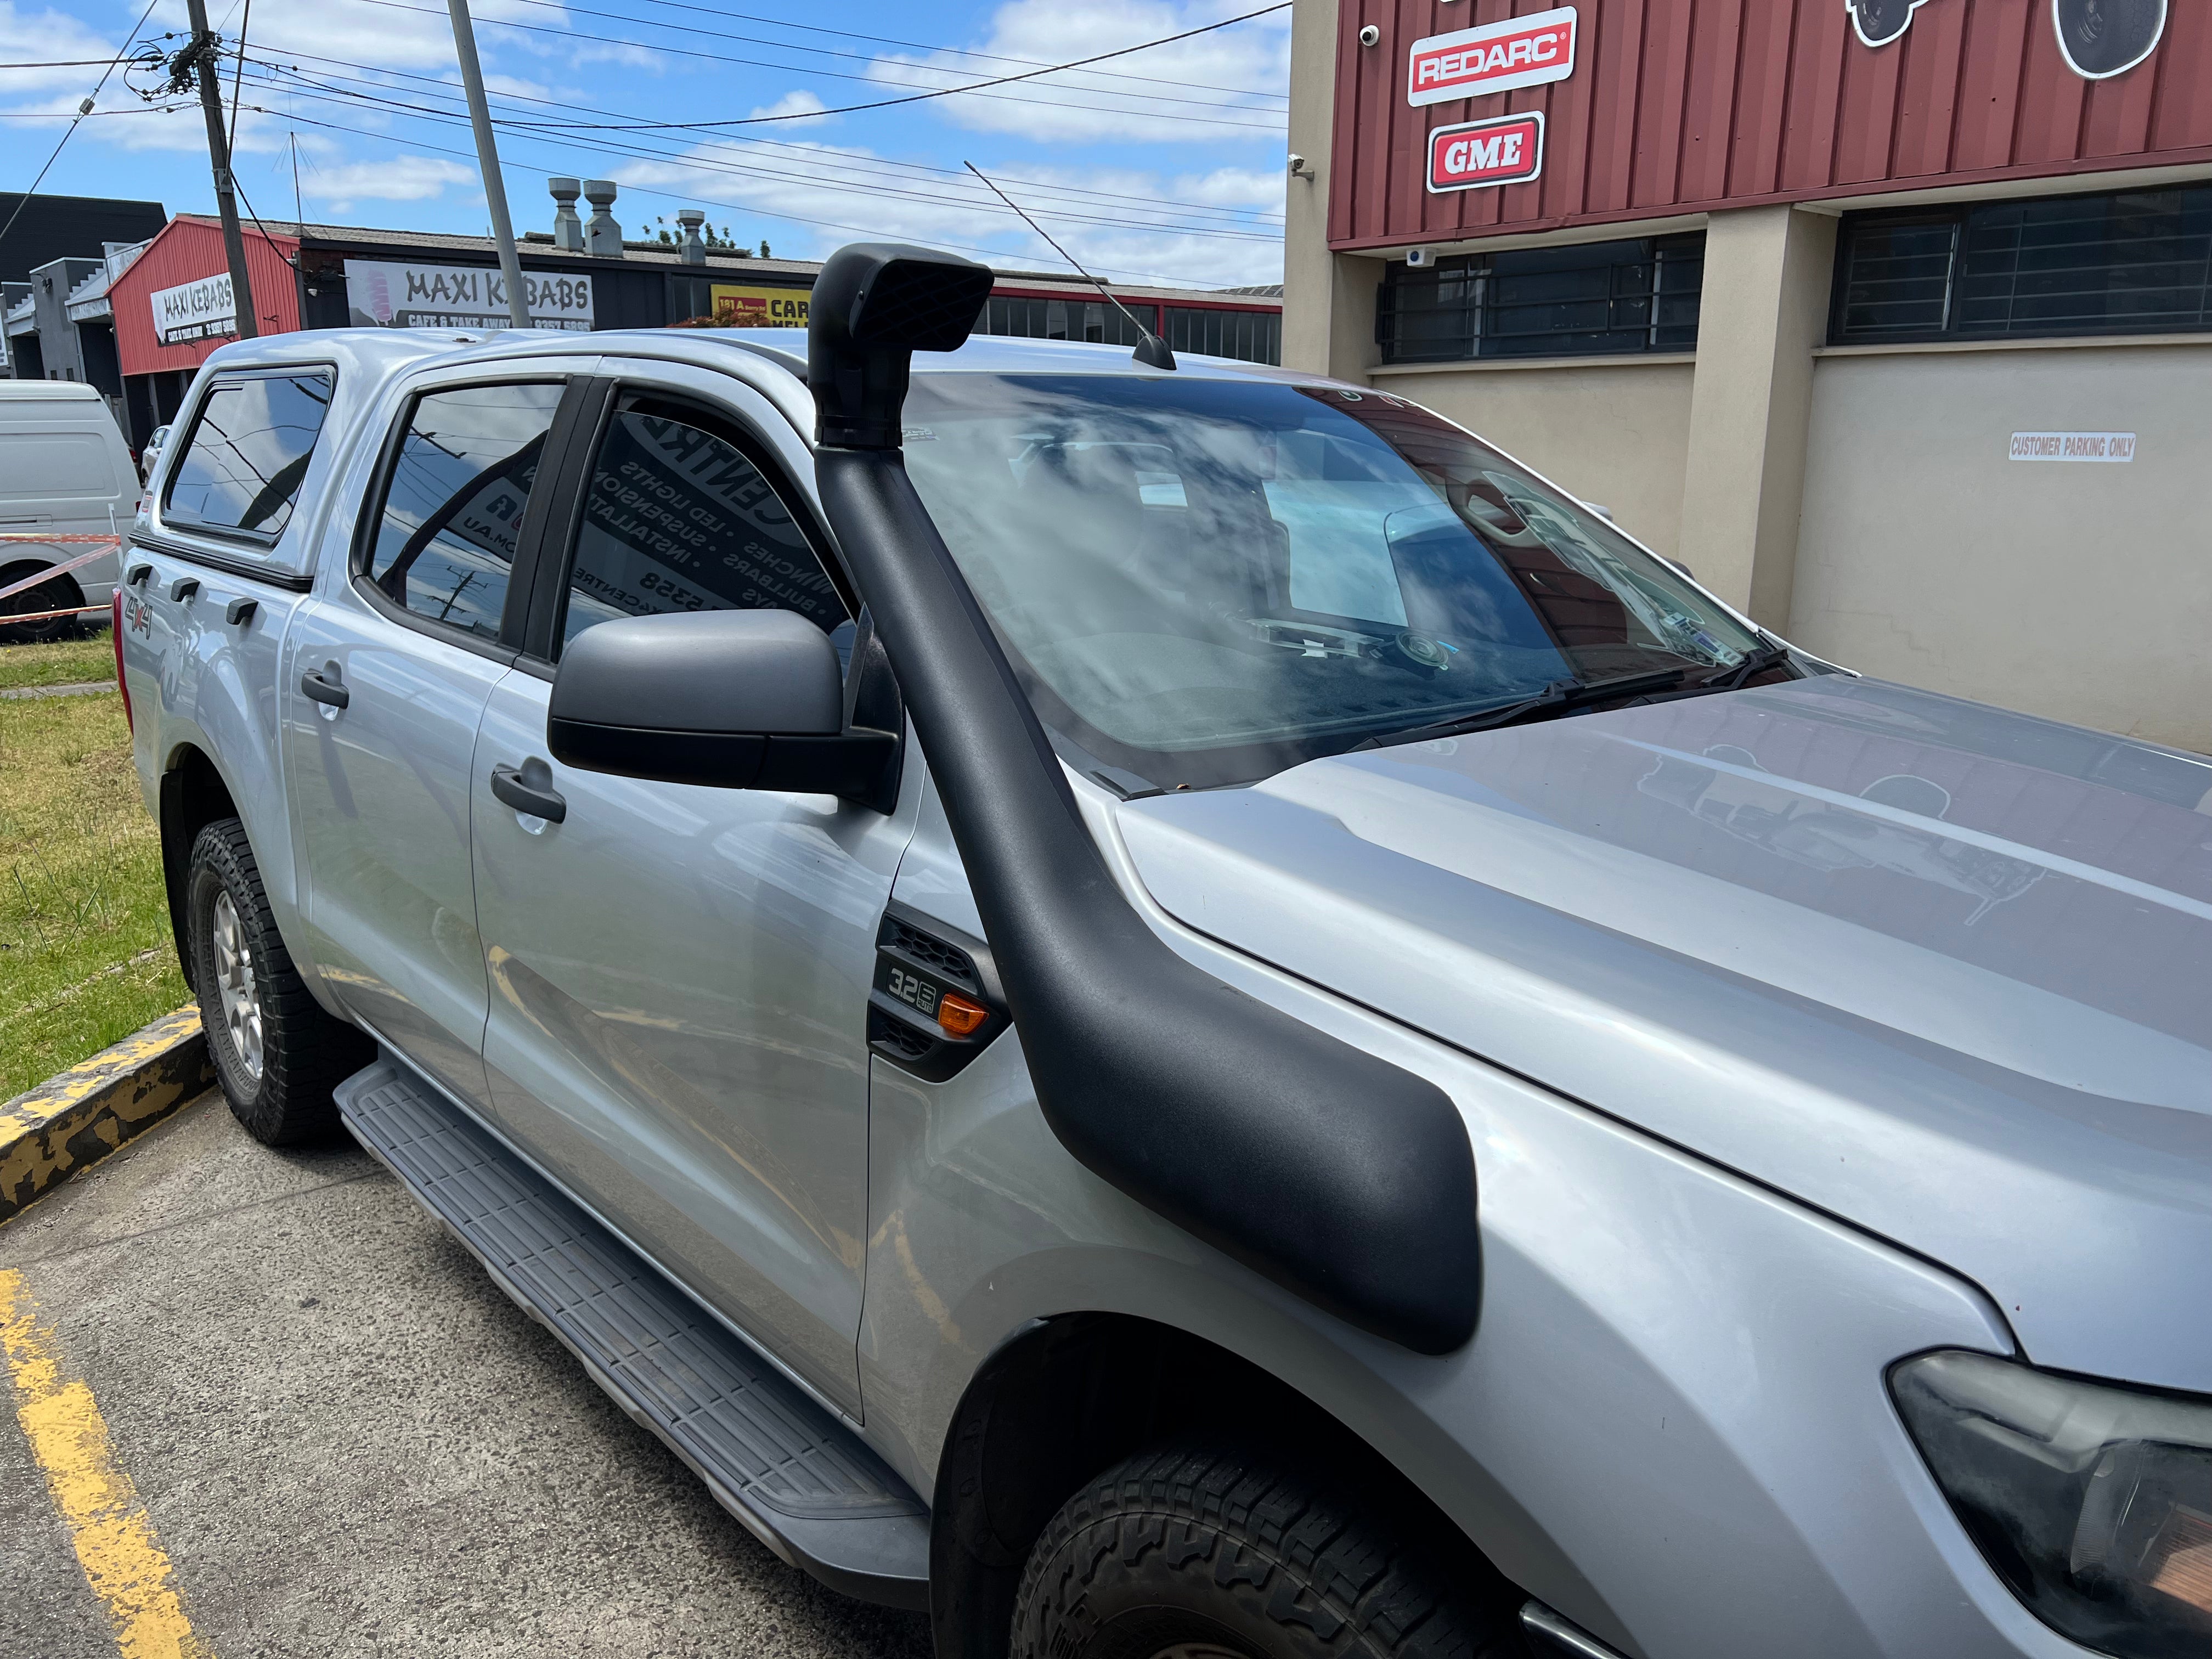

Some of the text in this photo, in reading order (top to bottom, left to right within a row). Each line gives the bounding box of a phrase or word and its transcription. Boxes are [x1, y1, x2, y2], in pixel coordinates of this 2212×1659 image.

[1418, 33, 1558, 85] REDARC
[1444, 132, 1523, 174] GME
[164, 278, 232, 322] MAXI KEBABS
[406, 270, 588, 311] MAXI KBABS
[408, 314, 511, 329] CAFE & TAKE AWAY
[2011, 436, 2135, 456] CUSTOMER PARKING ONLY
[889, 968, 918, 1003] 3.2
[918, 999, 933, 1012] AUTO
